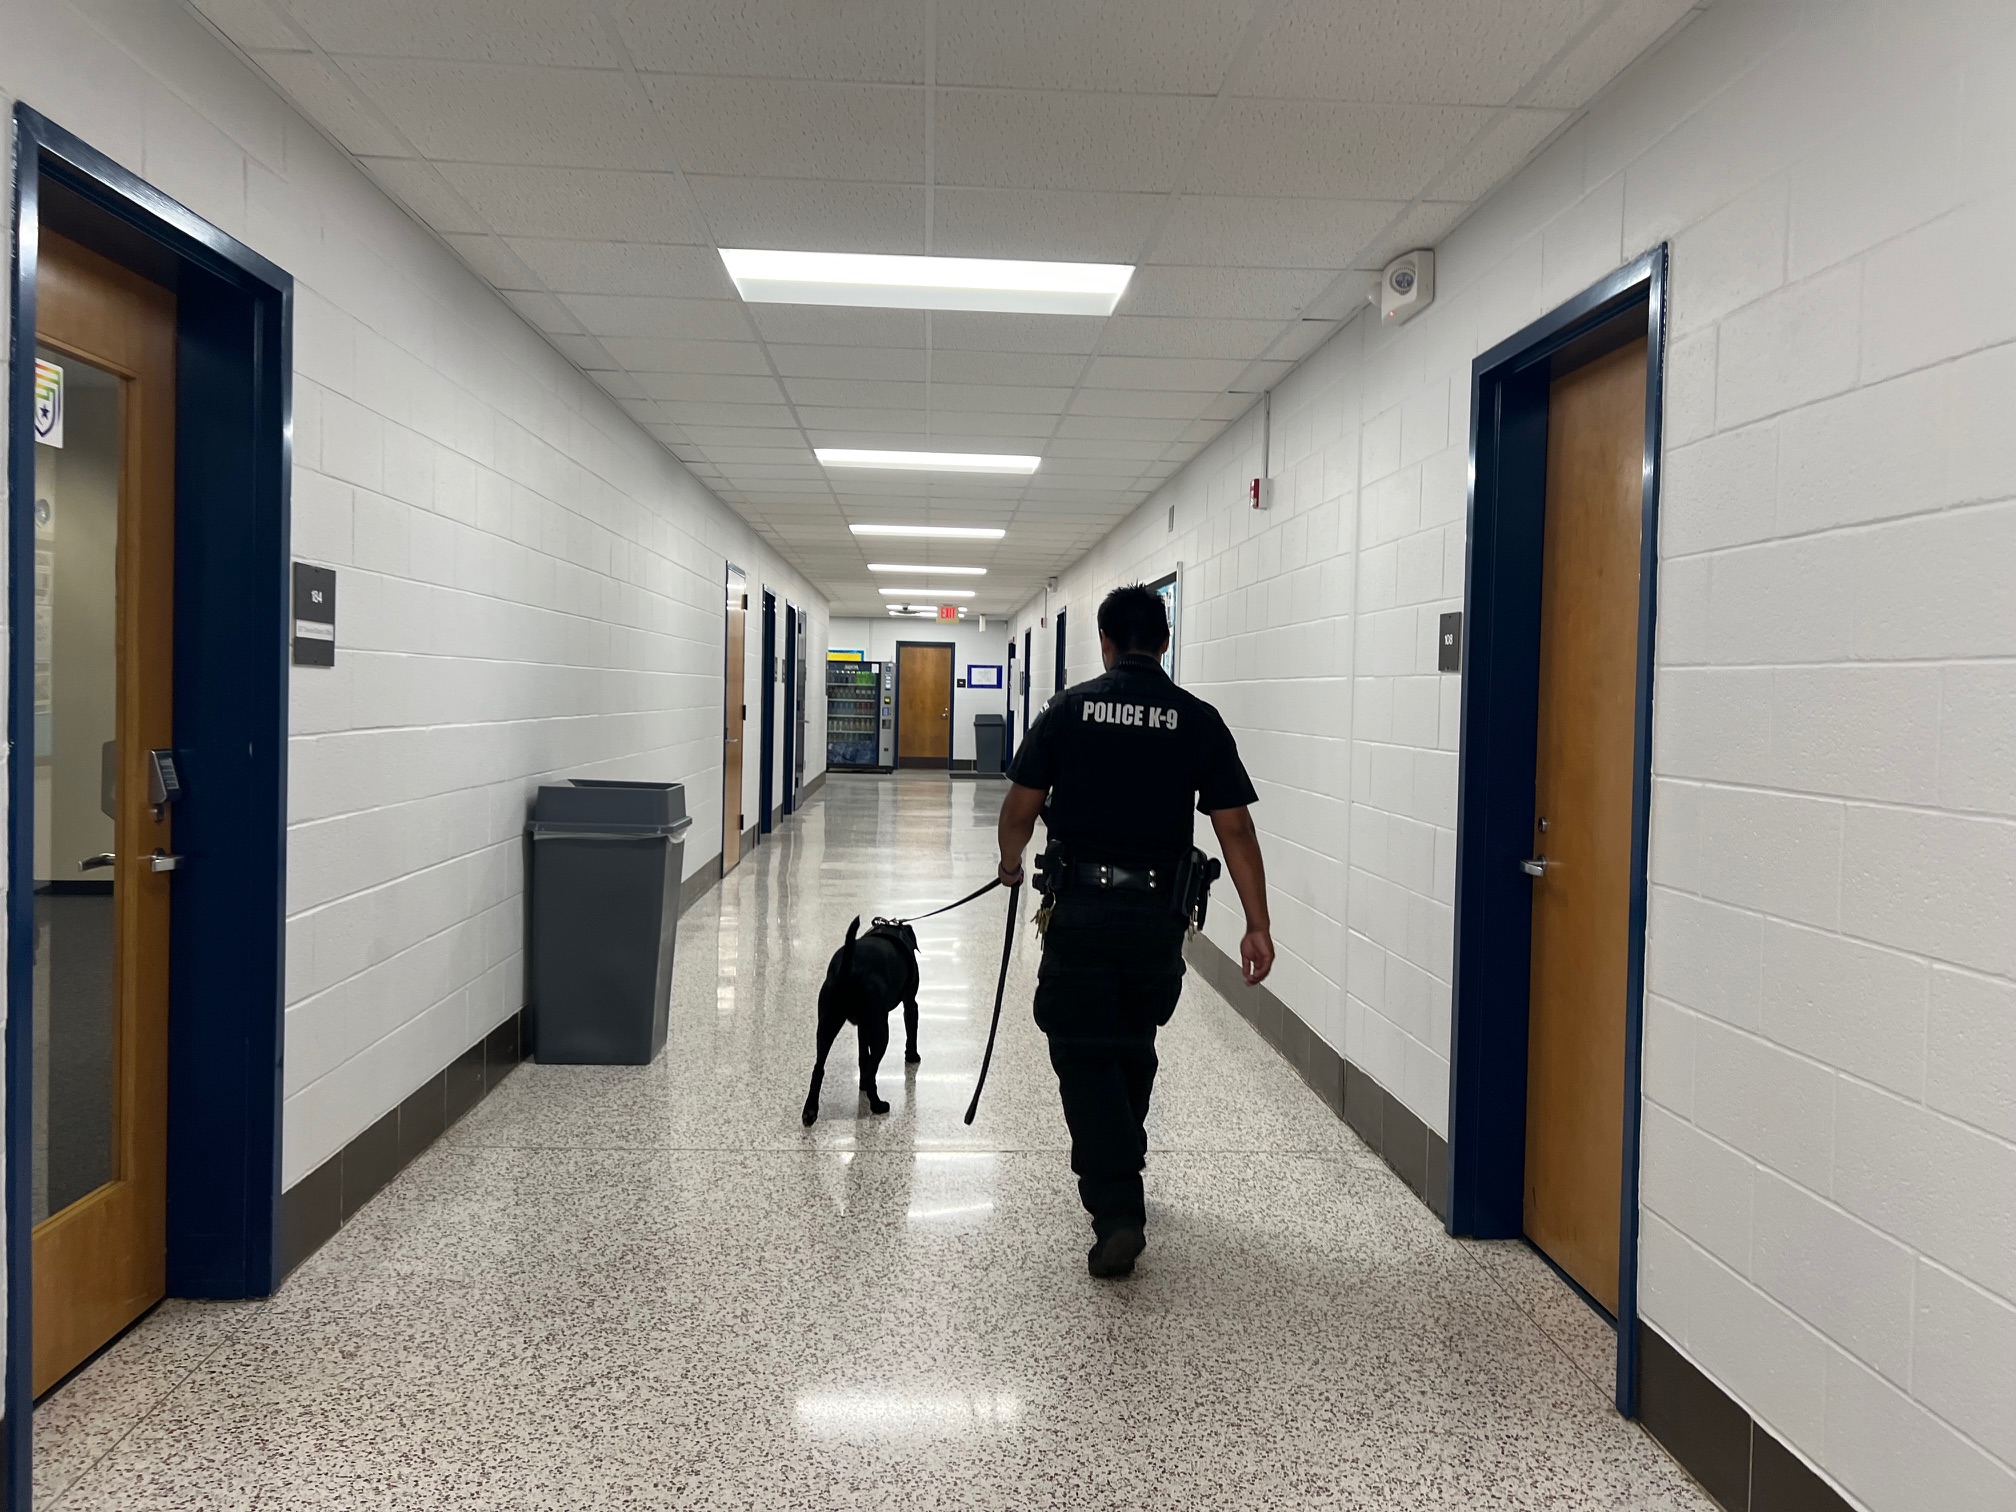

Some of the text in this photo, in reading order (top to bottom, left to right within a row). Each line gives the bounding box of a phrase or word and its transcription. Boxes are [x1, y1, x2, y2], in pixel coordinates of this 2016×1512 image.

[941, 607, 956, 618] EXIT
[1082, 700, 1178, 730] POLICE K-9
